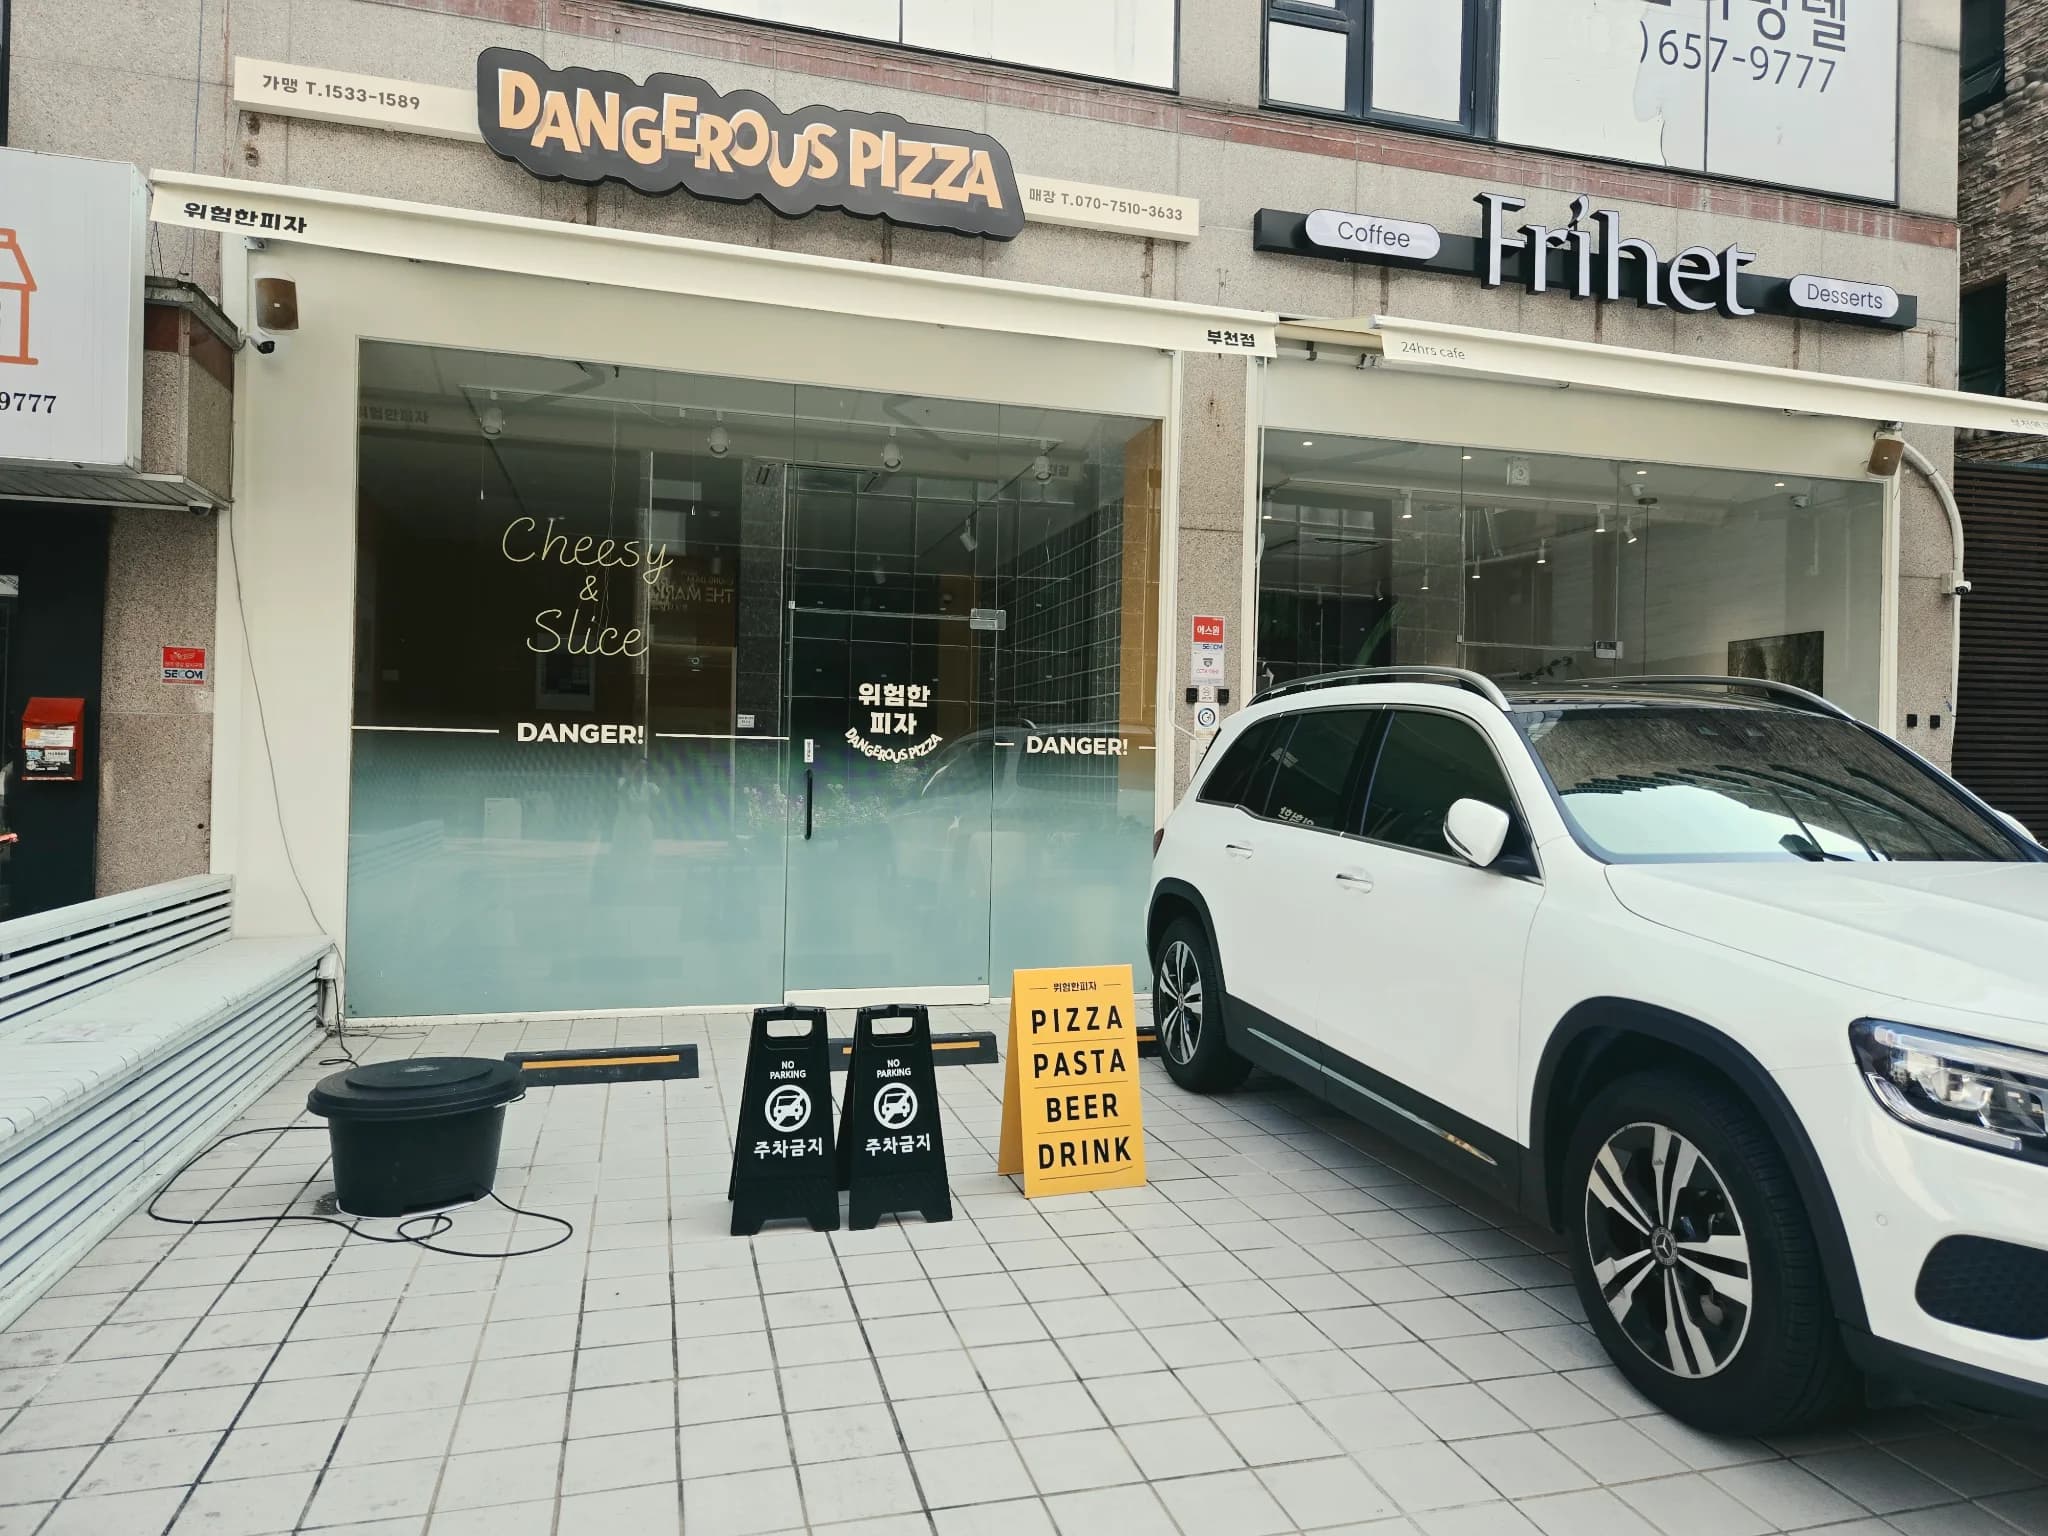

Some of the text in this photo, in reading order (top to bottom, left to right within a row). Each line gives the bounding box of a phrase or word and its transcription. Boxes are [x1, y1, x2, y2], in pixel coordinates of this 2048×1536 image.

[262, 74, 420, 110] 가맹 T.1533-1589
[498, 68, 1003, 209] DANGEROUS PIZZA
[1029, 188, 1183, 221] 매장 T.070-7510-3633
[184, 202, 307, 234] 위험한피자
[1338, 221, 1410, 248] Coffee
[1807, 283, 1883, 309] Desserts
[1207, 329, 1255, 347] 부천점
[1401, 341, 1465, 360] 24hrs cafe
[502, 516, 673, 584] Cheesy
[579, 575, 599, 602] &
[526, 608, 650, 657] Slice
[164, 669, 203, 680] SECOM
[858, 682, 931, 708] 위험한
[517, 722, 644, 744] DANGER!
[870, 712, 917, 735] 피자
[844, 727, 908, 764] DANGEROUS
[908, 733, 944, 760] PIZZA
[1026, 735, 1128, 756] DANGER!
[1053, 981, 1097, 993] 위험한피자
[1031, 1005, 1123, 1034] PIZZA
[769, 1069, 807, 1080] PARKING
[781, 1060, 795, 1070] NO
[876, 1067, 911, 1078] PARKING
[887, 1058, 900, 1068] NO
[1033, 1048, 1126, 1079] PASTA
[1046, 1093, 1119, 1123] BEER
[753, 1137, 823, 1160] 주차금지
[865, 1133, 931, 1157] 주차금지
[1038, 1136, 1132, 1170] DRINK
